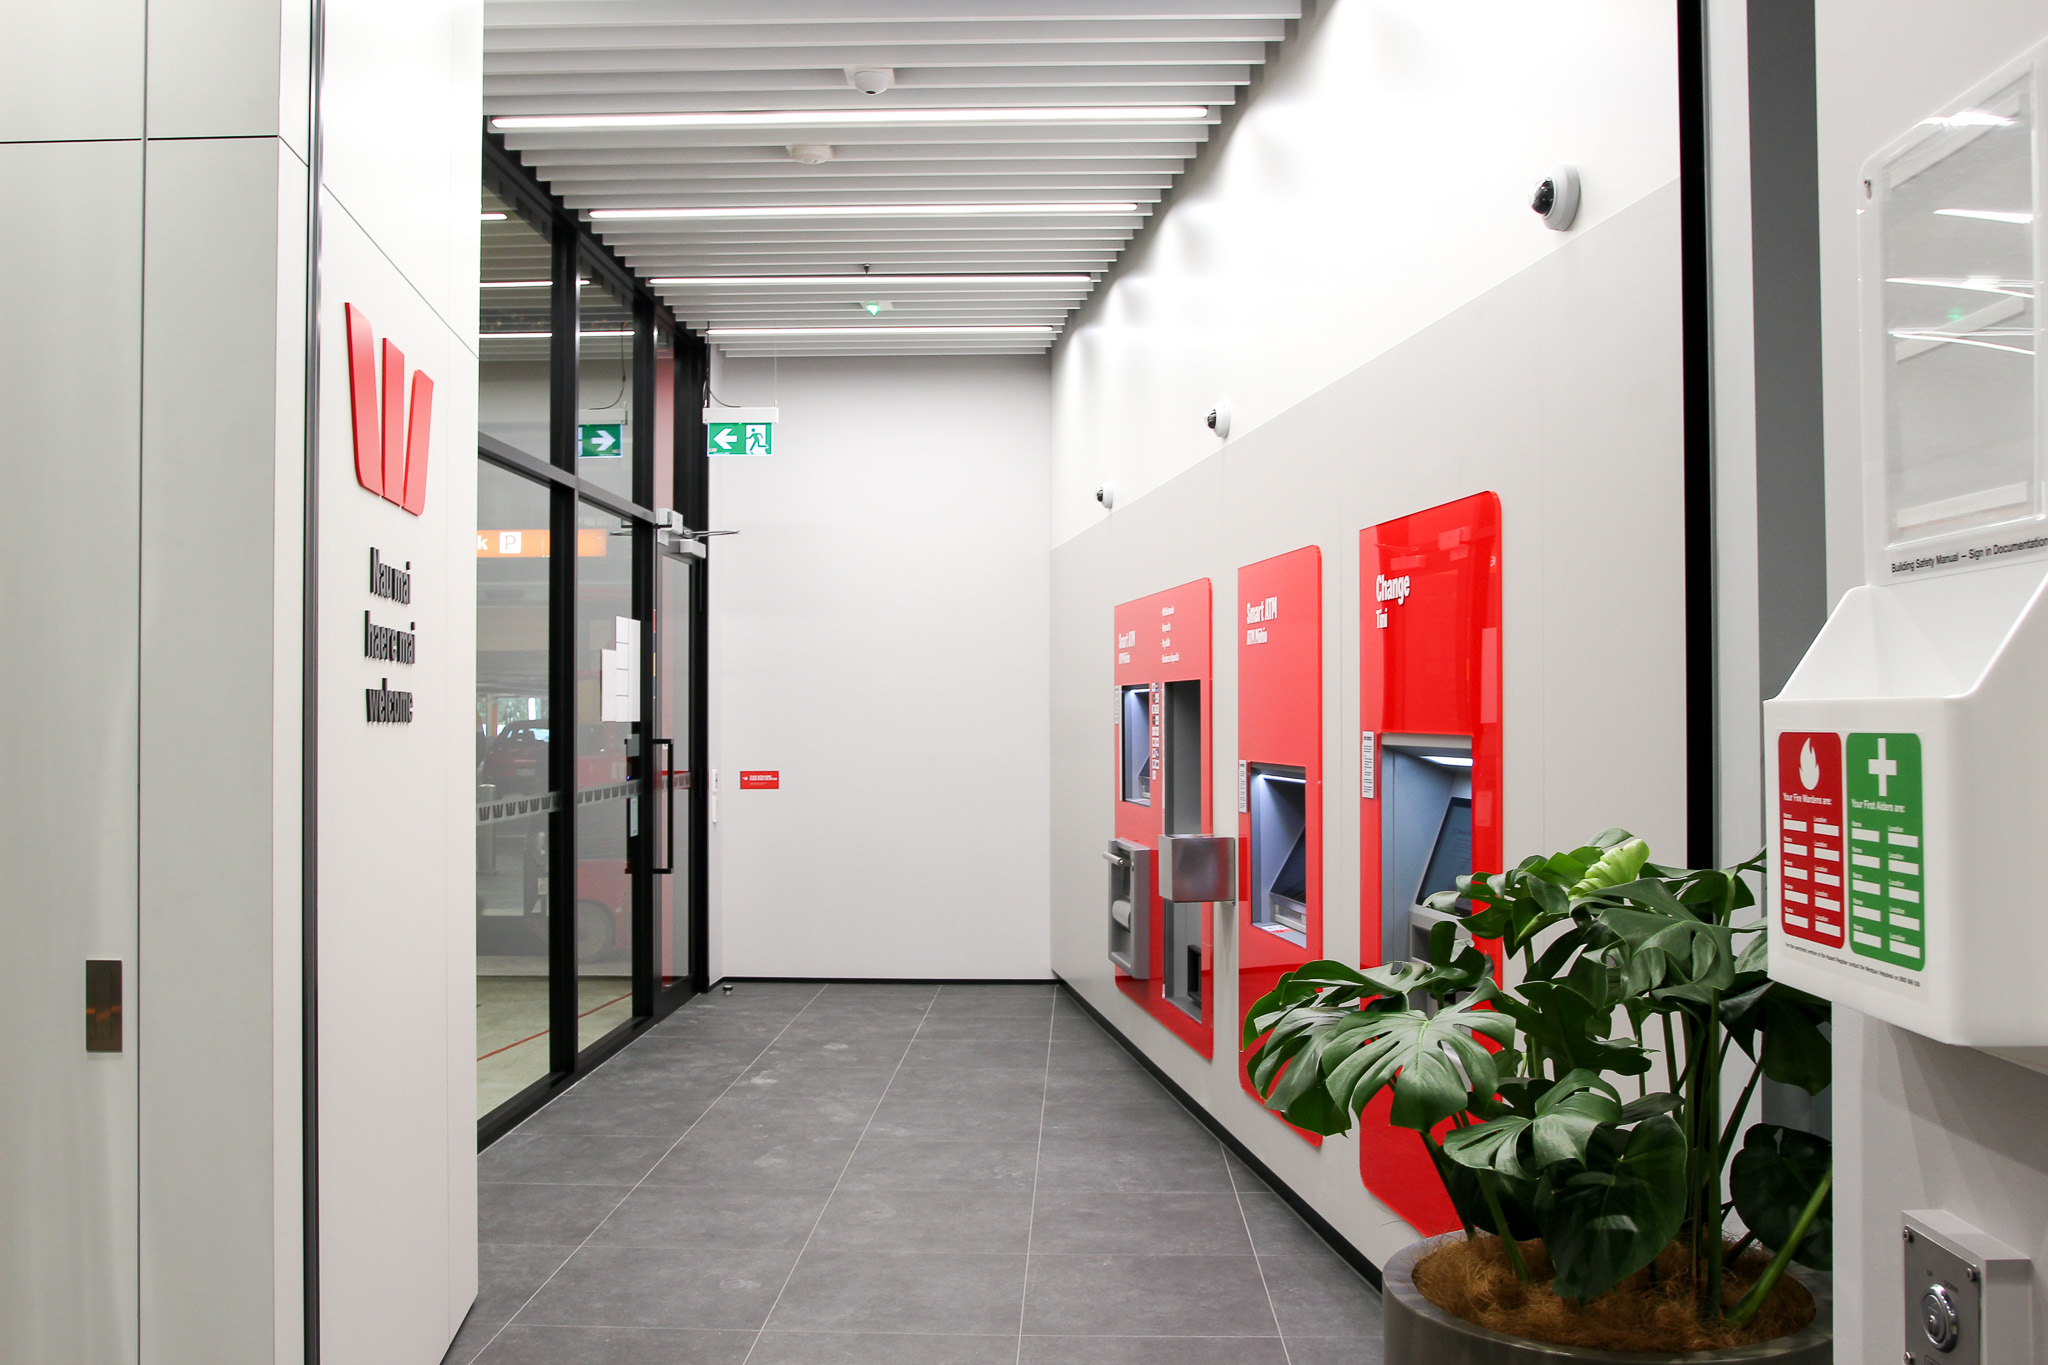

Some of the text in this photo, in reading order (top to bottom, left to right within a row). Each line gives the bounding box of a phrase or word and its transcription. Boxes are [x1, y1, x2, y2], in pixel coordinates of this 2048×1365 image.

[370, 546, 410, 605] Nau mai
[1892, 560, 1915, 573] Building
[1916, 557, 1935, 568] Safety
[1936, 551, 1959, 565] Manual
[1968, 548, 1983, 560] Sign
[1985, 546, 1992, 556] in
[1376, 573, 1410, 606] Change
[364, 609, 415, 665] haere mai
[365, 677, 414, 724] welcome
